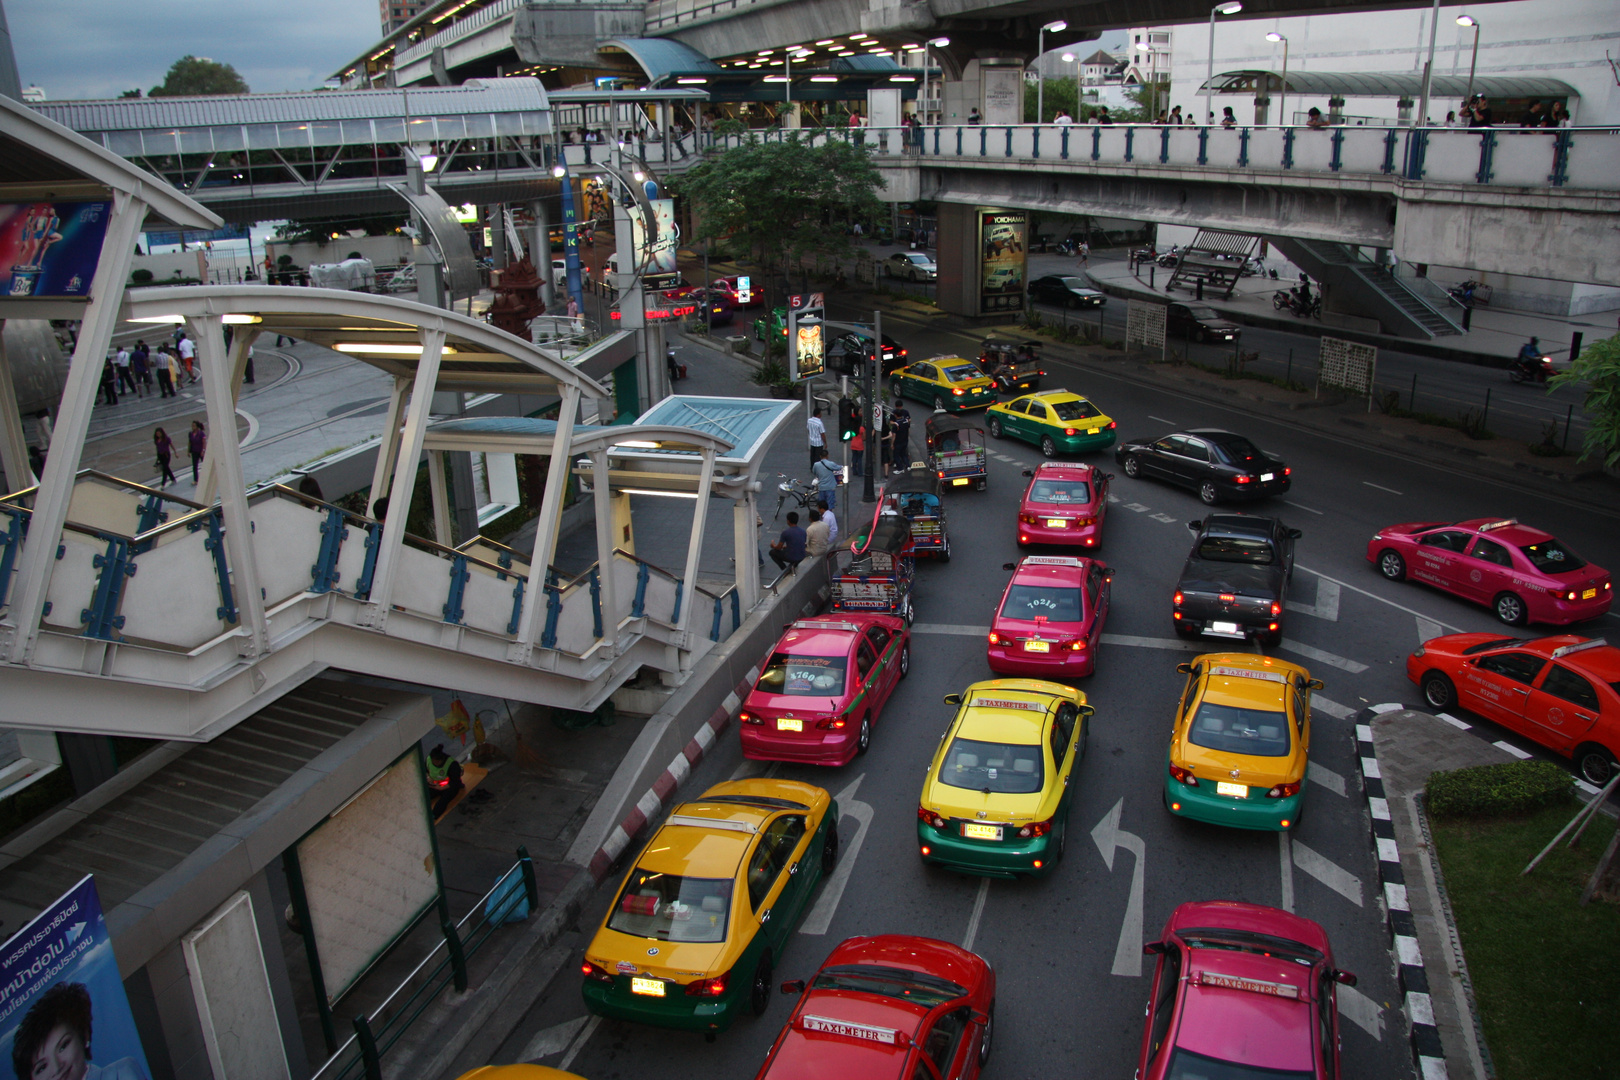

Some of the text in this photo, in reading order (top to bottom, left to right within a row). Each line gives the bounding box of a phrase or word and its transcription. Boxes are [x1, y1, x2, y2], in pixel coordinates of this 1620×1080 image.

[994, 216, 1025, 224] YOKOHAMA
[792, 296, 801, 307] 5
[673, 306, 695, 316] CITY
[1027, 598, 1056, 609] 70218
[1227, 668, 1267, 679] TAXI-METER
[985, 700, 1028, 709] TAXI-METER
[1213, 977, 1278, 995] TAXI-METER
[818, 1022, 879, 1040] TAXI-METER
